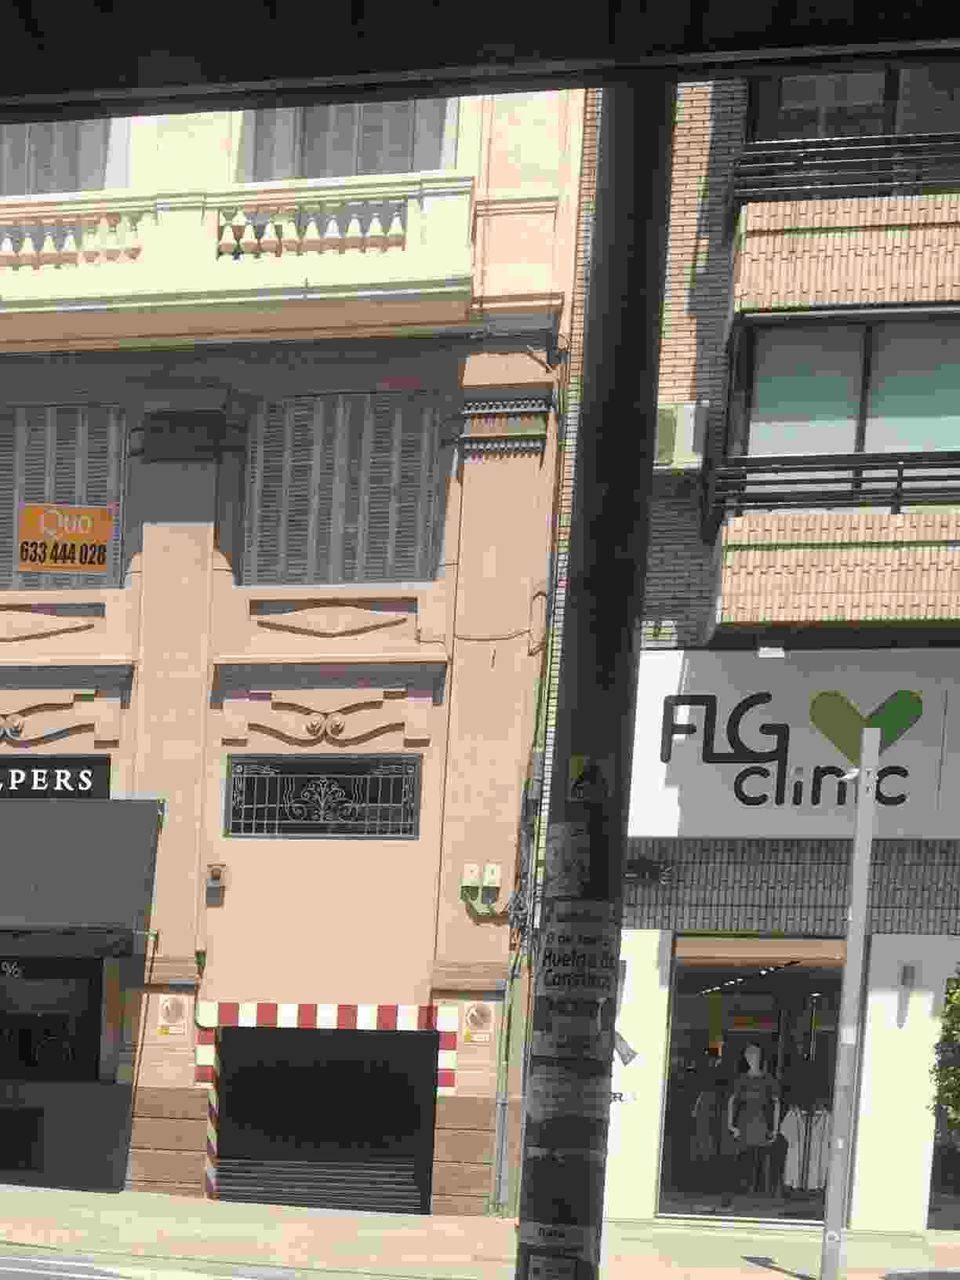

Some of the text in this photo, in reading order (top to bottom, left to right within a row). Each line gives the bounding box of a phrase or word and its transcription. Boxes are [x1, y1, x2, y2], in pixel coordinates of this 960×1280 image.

[20, 540, 48, 564] 633
[50, 542, 76, 565] 444
[734, 765, 909, 806] clinc
